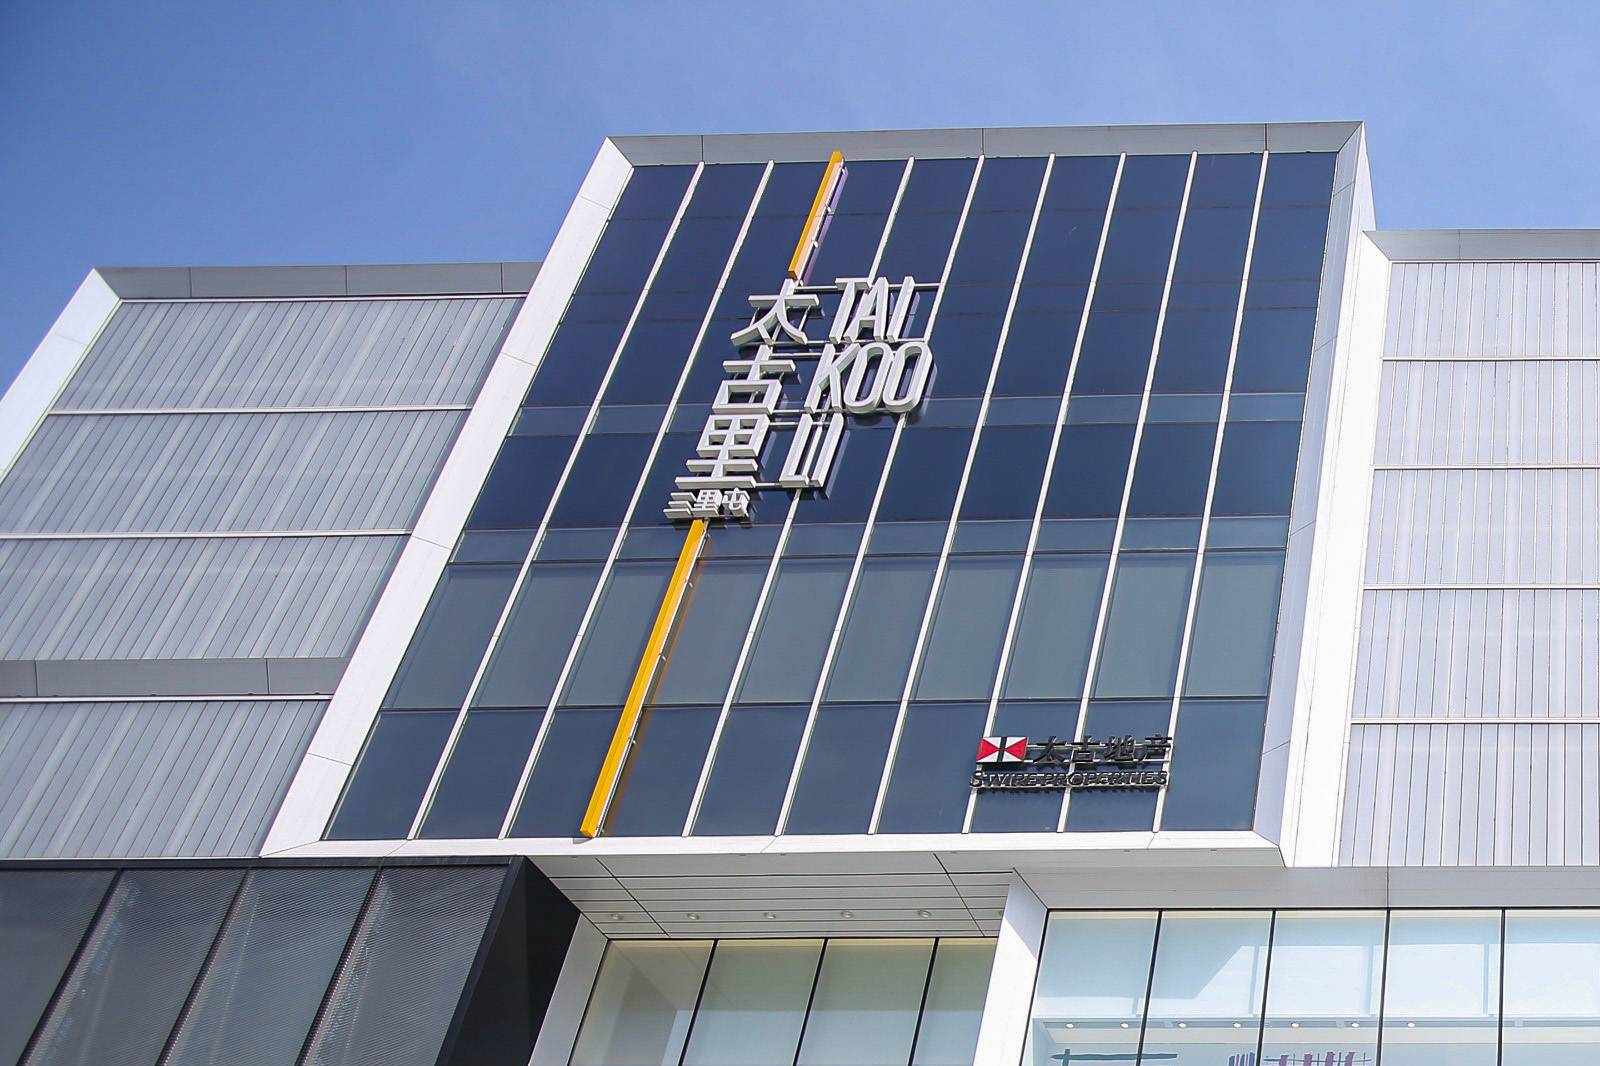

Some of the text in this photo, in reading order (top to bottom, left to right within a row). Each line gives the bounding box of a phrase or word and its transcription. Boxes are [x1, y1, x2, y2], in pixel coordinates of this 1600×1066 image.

[828, 275, 915, 345] TAI
[675, 277, 820, 489] 太古里
[803, 341, 934, 414] KOO
[779, 412, 844, 488] LI
[663, 487, 750, 519] 三里屯
[969, 770, 1168, 788] SWIRE PROPERTIES
[1032, 734, 1173, 763] 太古地产
